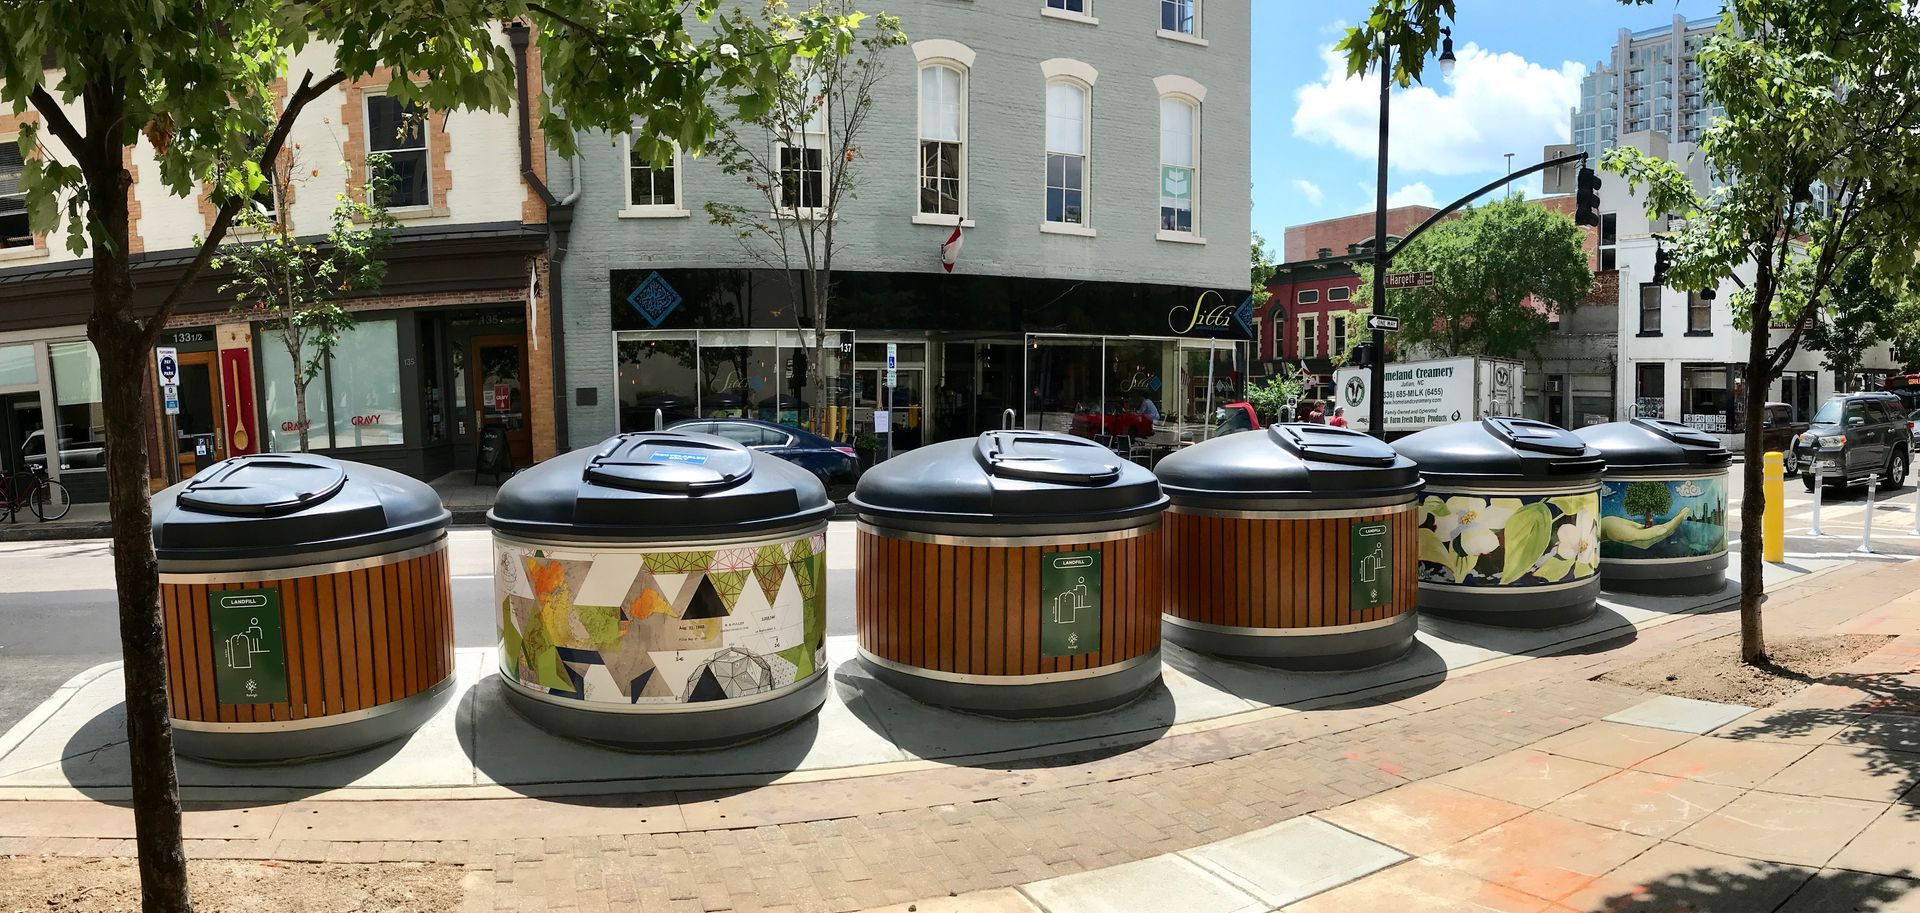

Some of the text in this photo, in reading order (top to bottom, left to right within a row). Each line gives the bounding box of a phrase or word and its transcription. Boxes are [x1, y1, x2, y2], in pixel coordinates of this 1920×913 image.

[1389, 273, 1415, 287] Hargett
[1168, 289, 1236, 334] Sitti
[840, 343, 852, 353] 137
[1384, 366, 1454, 381] meland Creamery
[1383, 387, 1443, 399] 336) 685-MILK (6455)
[351, 414, 381, 426] GRAVY
[1427, 414, 1448, 422] Products
[281, 419, 311, 431] GRAY
